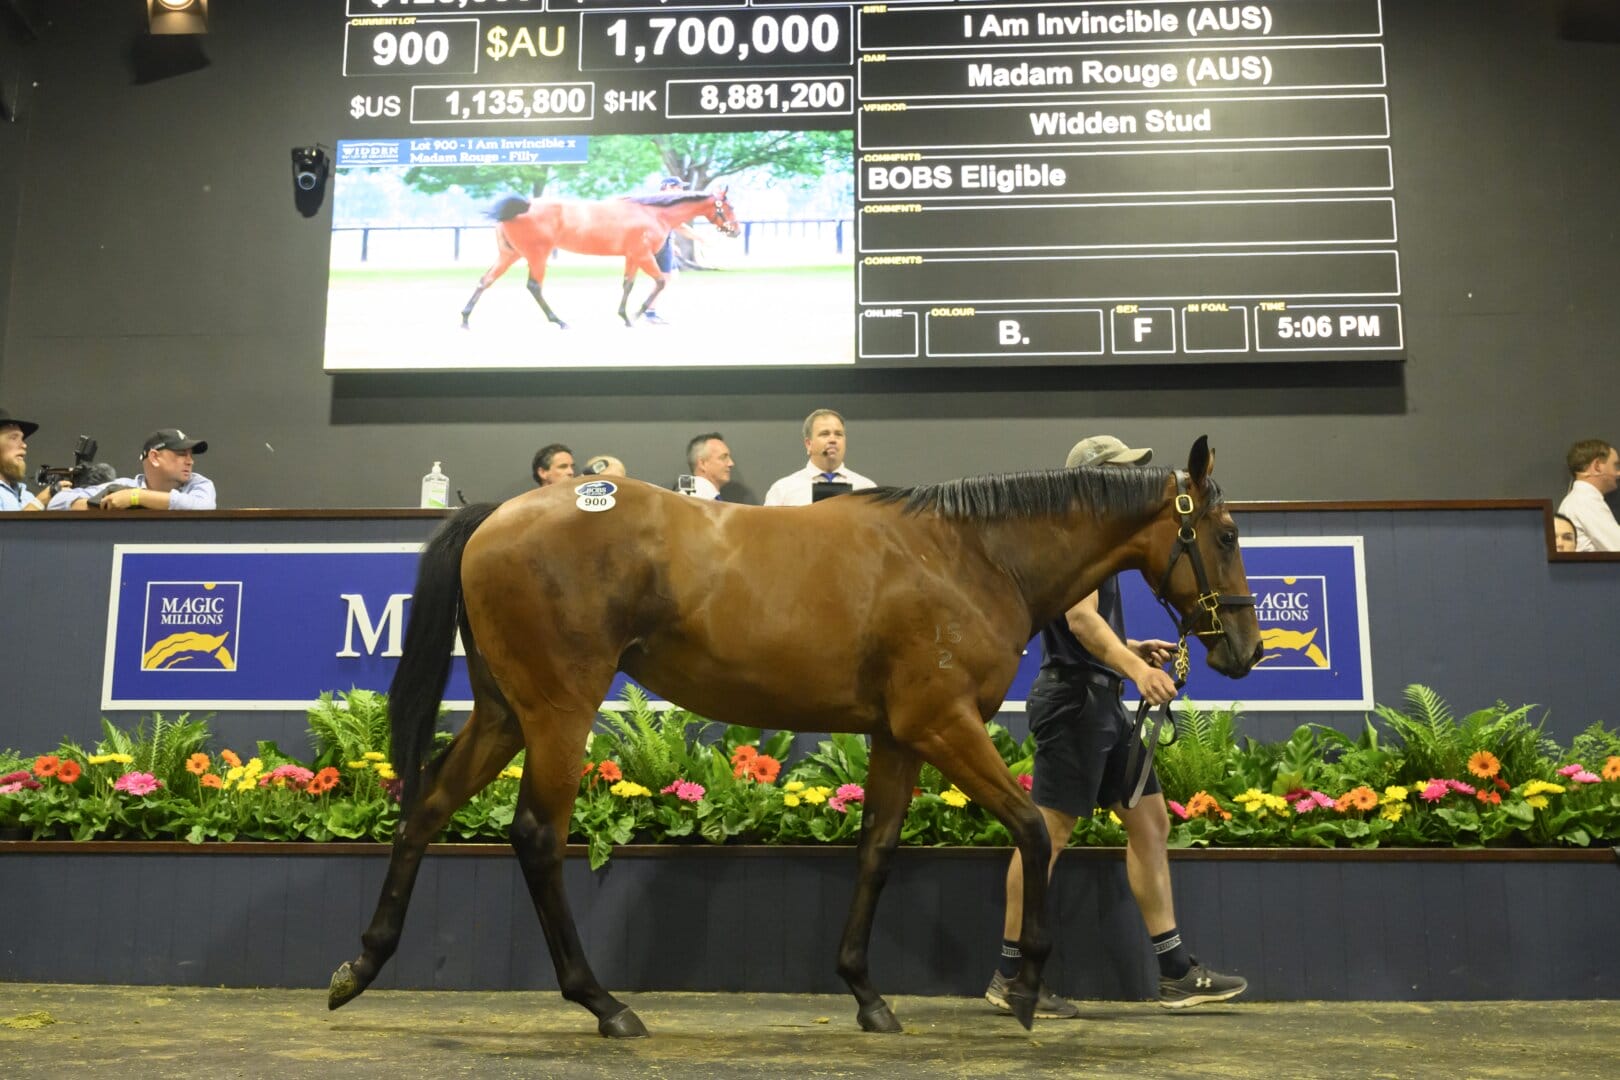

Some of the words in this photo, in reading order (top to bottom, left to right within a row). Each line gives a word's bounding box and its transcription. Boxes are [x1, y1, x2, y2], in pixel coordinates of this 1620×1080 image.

[398, 17, 417, 25] LOT
[963, 14, 974, 38] I
[979, 13, 1030, 37] Am
[1037, 9, 1179, 36] Invincible
[1186, 6, 1273, 37] (AUS)
[373, 31, 449, 66] 900
[486, 26, 565, 61] $AU
[606, 14, 839, 63] 1,700,000
[967, 63, 1073, 87] Madam
[1081, 60, 1178, 87] Rouge
[1186, 56, 1273, 87] (AUS)
[350, 95, 401, 119] $US
[446, 88, 586, 118] 1,135,800
[603, 90, 657, 113] $HK
[700, 82, 845, 114] 8,881,200
[1029, 112, 1137, 135] Widden
[1145, 108, 1212, 133] Stud
[410, 140, 430, 150] Lot
[434, 140, 458, 150] 900
[476, 139, 498, 149] Am
[501, 137, 567, 148] Invincible
[410, 153, 457, 163] Madam
[509, 151, 539, 162] Filly
[868, 166, 952, 190] BOBS
[961, 163, 1066, 192] Eligible
[864, 256, 923, 265] COMMENTS
[864, 309, 903, 317] ONLINE
[931, 308, 975, 316] COLOUR
[1116, 305, 1138, 314] SEX
[1187, 304, 1199, 312] IN
[1201, 303, 1229, 311] FOAL
[1259, 302, 1286, 311] TIME
[999, 320, 1030, 345] B.
[1134, 317, 1152, 342] F
[1278, 316, 1333, 338] 5:06
[1339, 315, 1380, 337] PM
[585, 498, 607, 506] 900
[161, 597, 224, 614] MAGIC
[1251, 592, 1309, 609] AGIC
[161, 614, 223, 625] MILLIONS
[1255, 609, 1310, 622] ILLIONS
